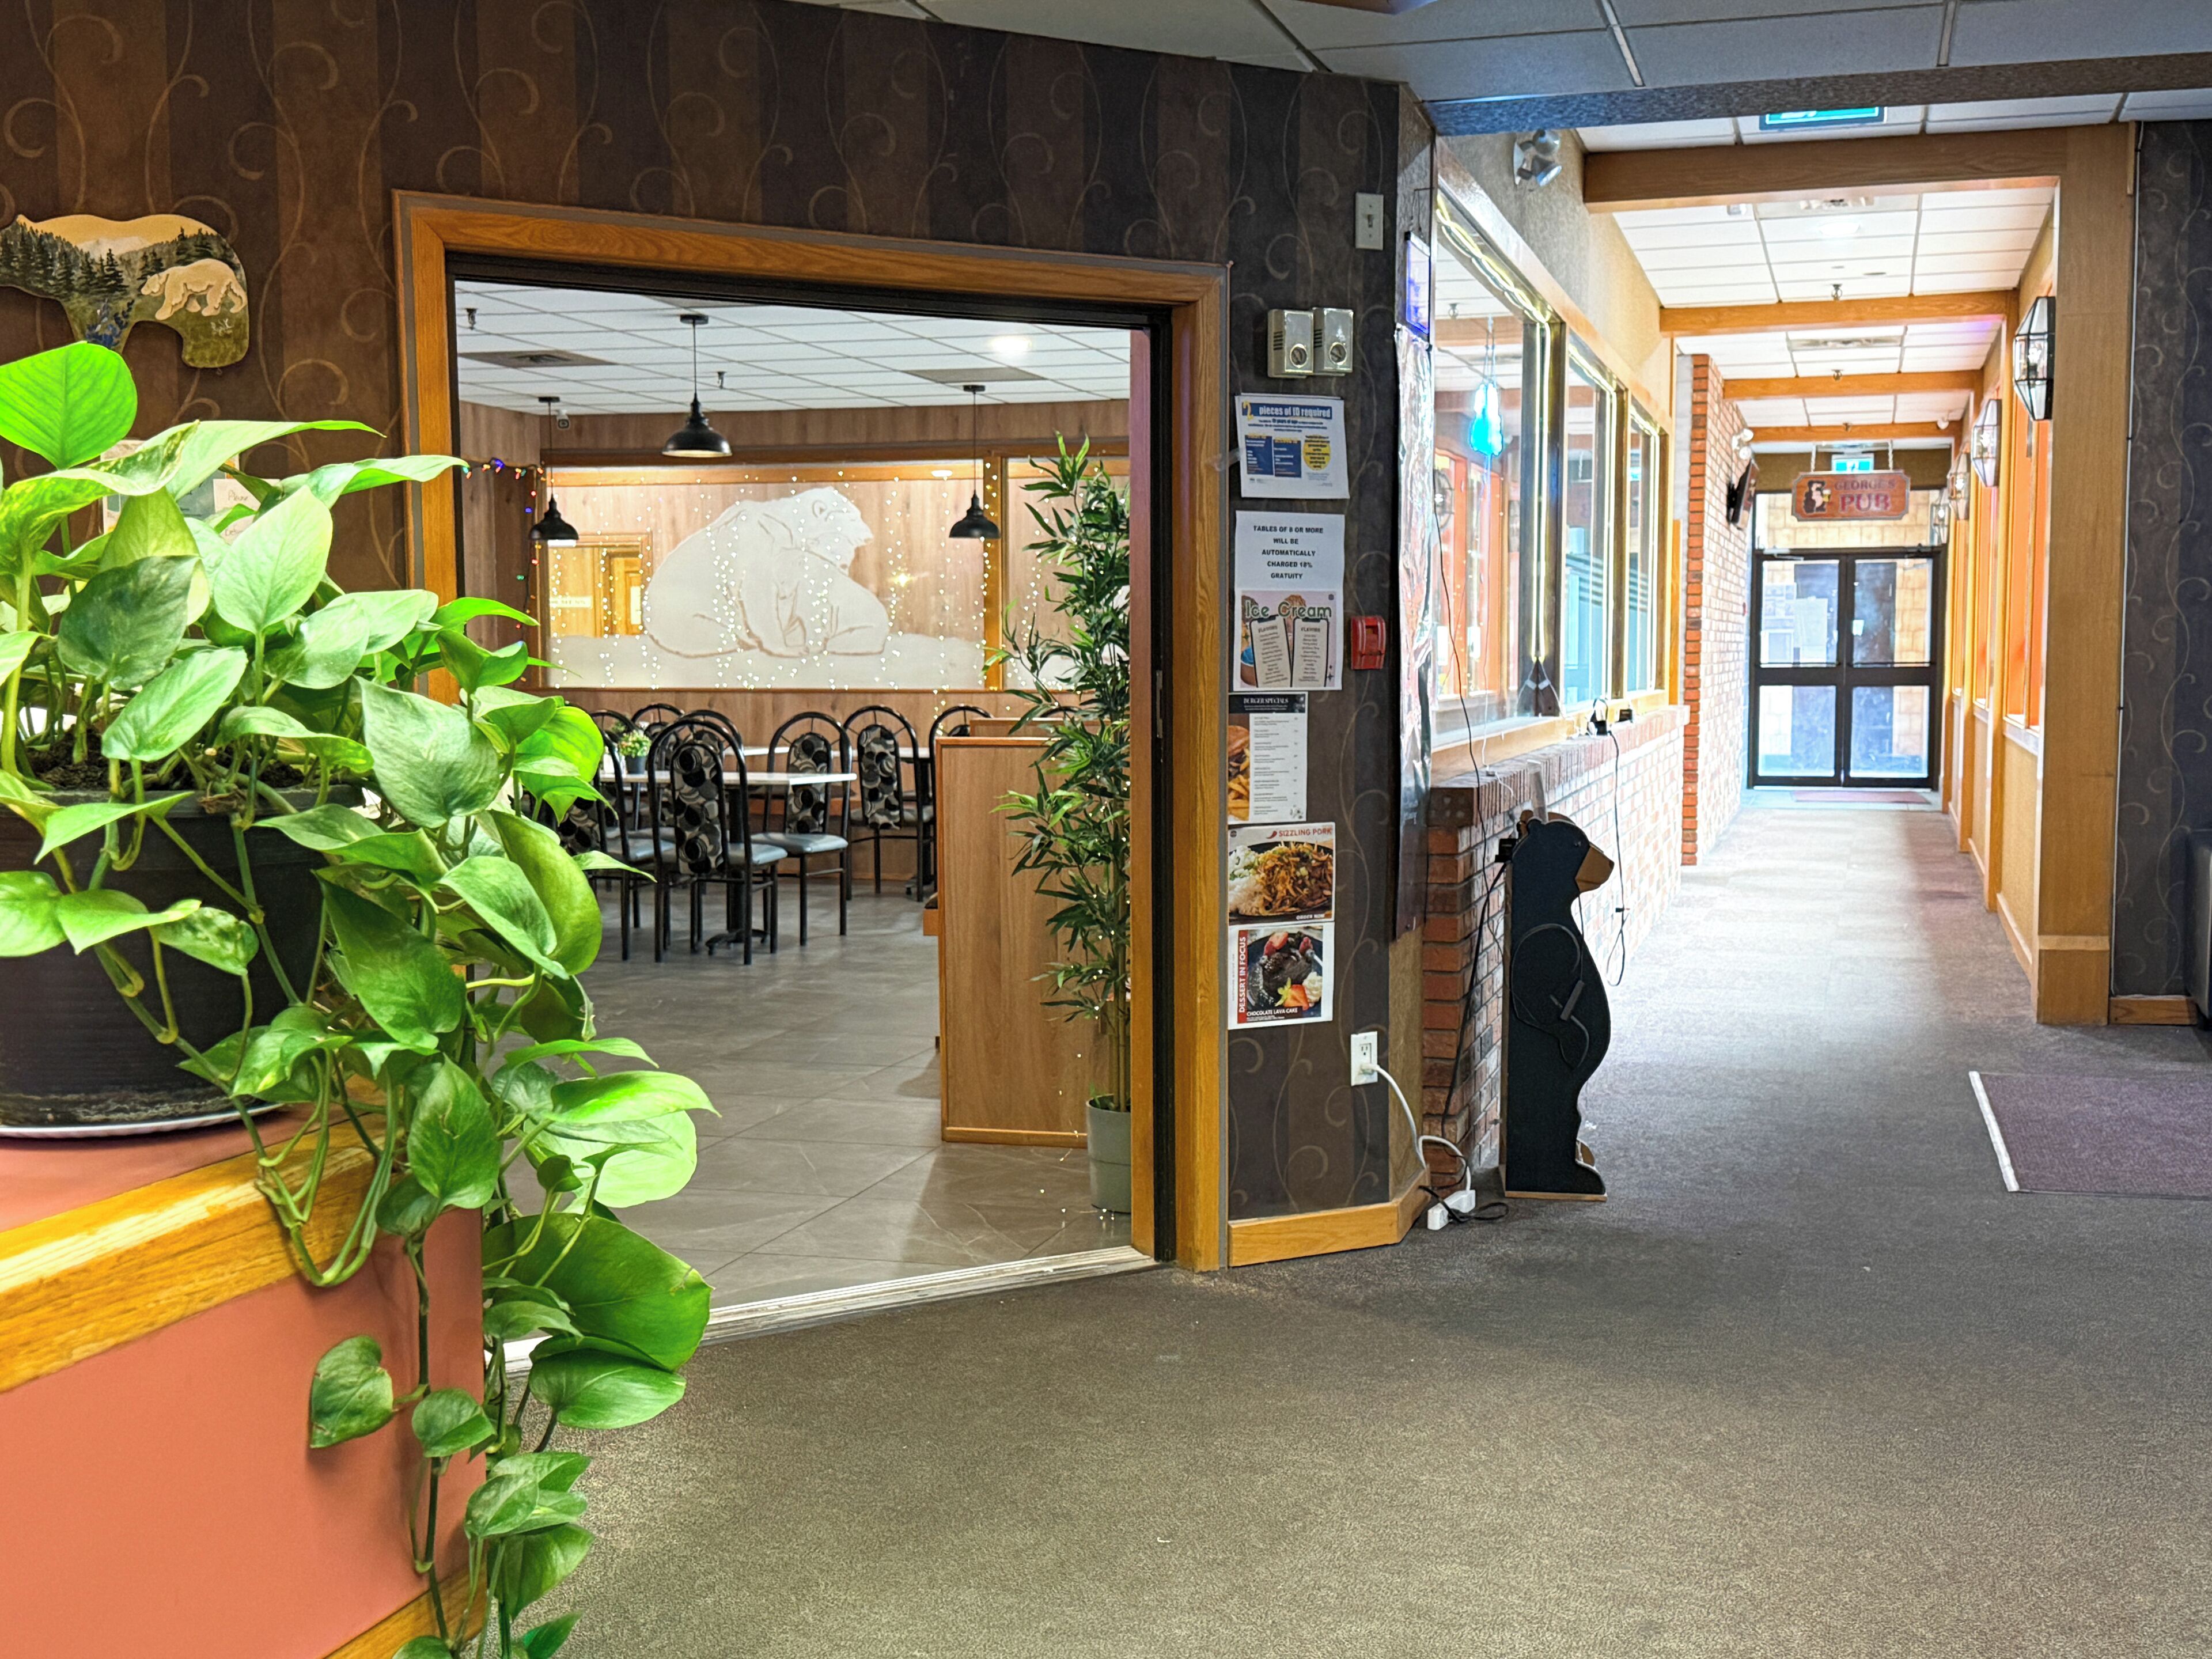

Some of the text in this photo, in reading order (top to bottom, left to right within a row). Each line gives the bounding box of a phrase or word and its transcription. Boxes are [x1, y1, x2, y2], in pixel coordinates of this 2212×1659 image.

[1243, 401, 1331, 421] 2 pieces of ID required
[1839, 494, 1891, 512] PUB
[1245, 600, 1332, 618] Ice Cream
[1279, 827, 1332, 837] SIZZLING PORK
[1240, 967, 1246, 976] IN
